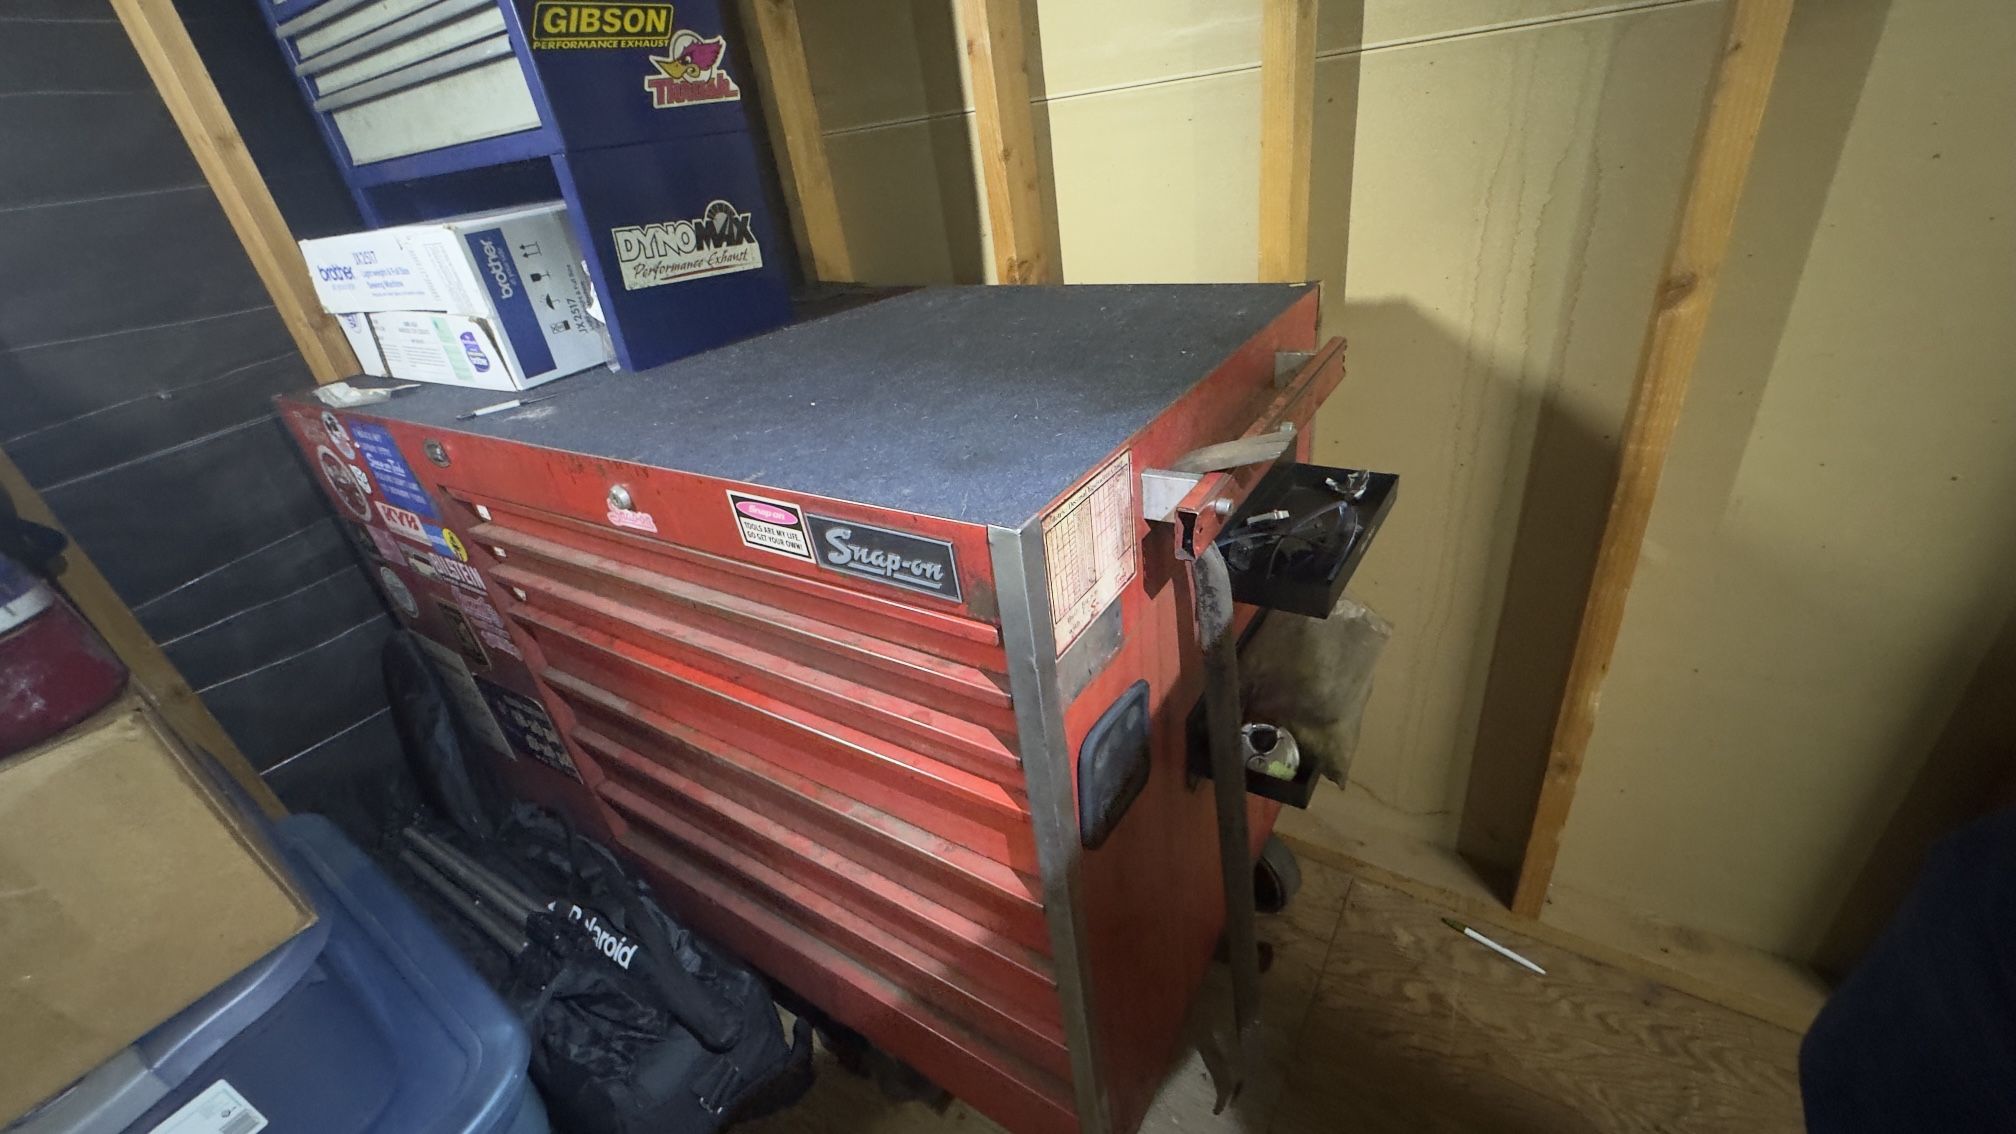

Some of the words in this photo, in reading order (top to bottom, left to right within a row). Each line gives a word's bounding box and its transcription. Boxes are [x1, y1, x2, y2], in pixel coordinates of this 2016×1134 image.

[543, 7, 667, 33] GIBSON
[533, 40, 618, 50] PERFORMANCE
[620, 39, 669, 48] EXHAUST
[317, 265, 354, 281] brother
[480, 239, 513, 300] brother
[633, 258, 704, 281] Performance
[707, 248, 749, 266] Exhaust
[744, 521, 763, 533] TOOLS
[764, 526, 775, 536] ARE
[776, 530, 786, 538] MY
[747, 530, 756, 539] GO
[756, 533, 767, 541] GET
[768, 536, 785, 546] YOUR
[785, 540, 803, 551] OWN!
[825, 528, 944, 581] Snap-on
